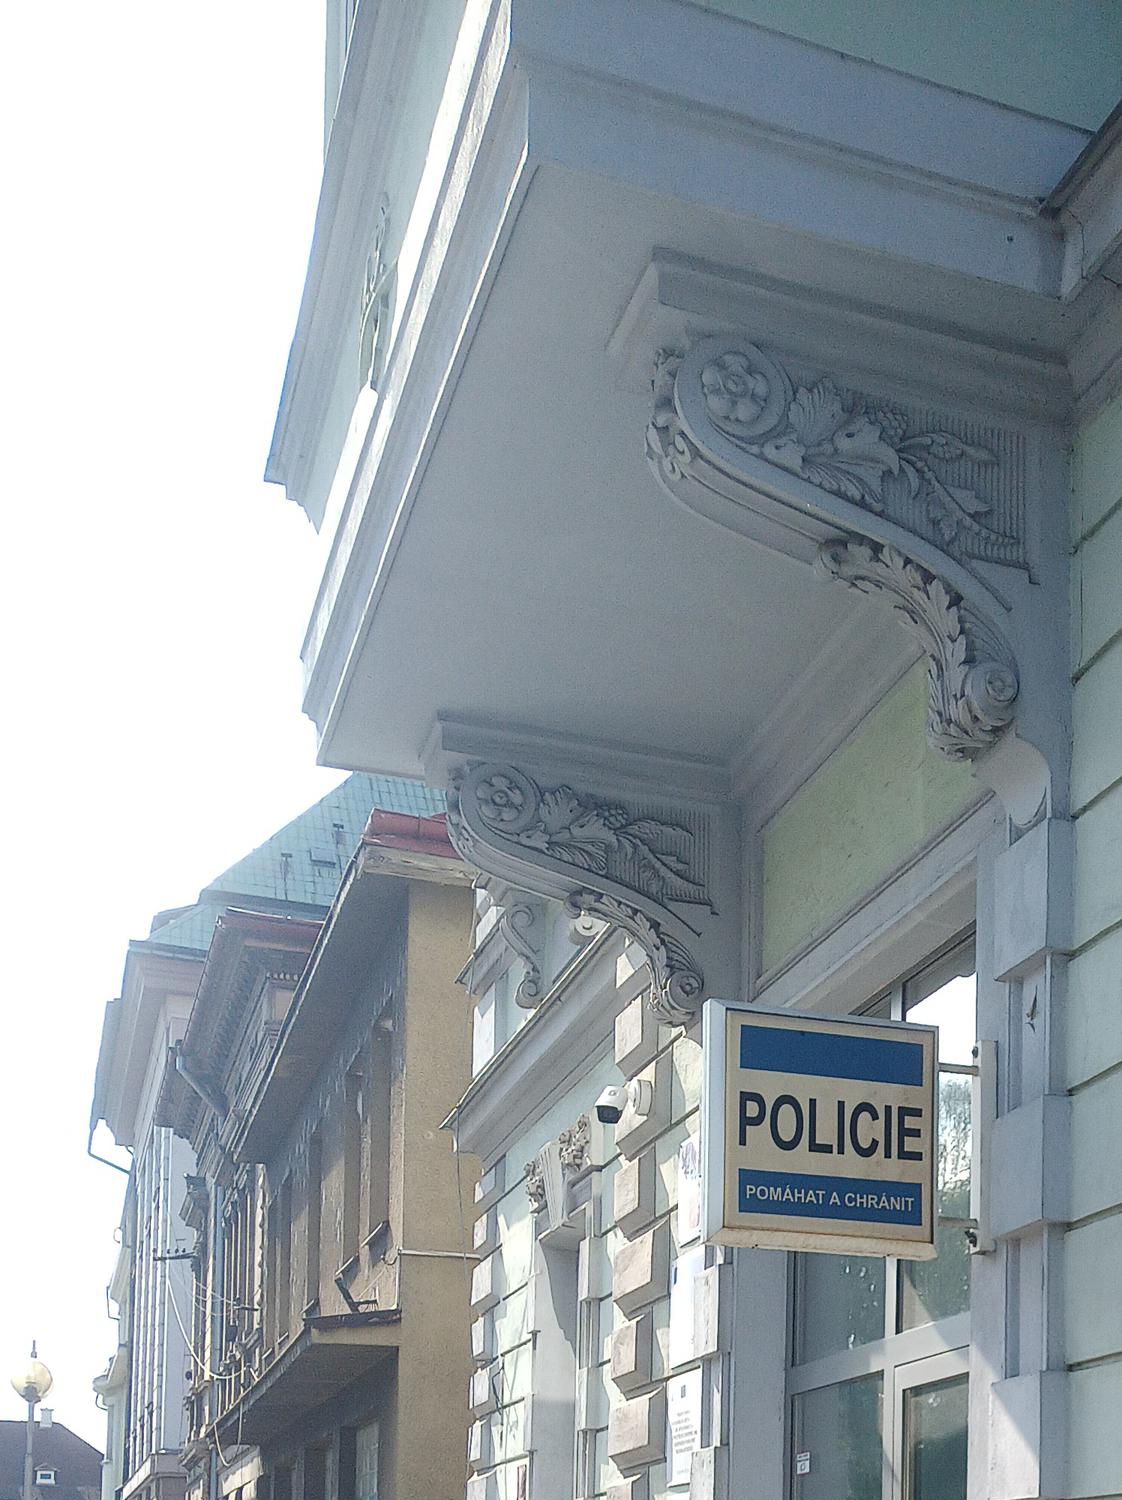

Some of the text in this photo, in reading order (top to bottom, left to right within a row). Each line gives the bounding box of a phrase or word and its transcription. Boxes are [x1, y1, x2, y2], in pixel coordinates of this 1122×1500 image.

[738, 1091, 923, 1161] POLICIE
[746, 1184, 915, 1212] POMÁHAT A CHRÁNIT
